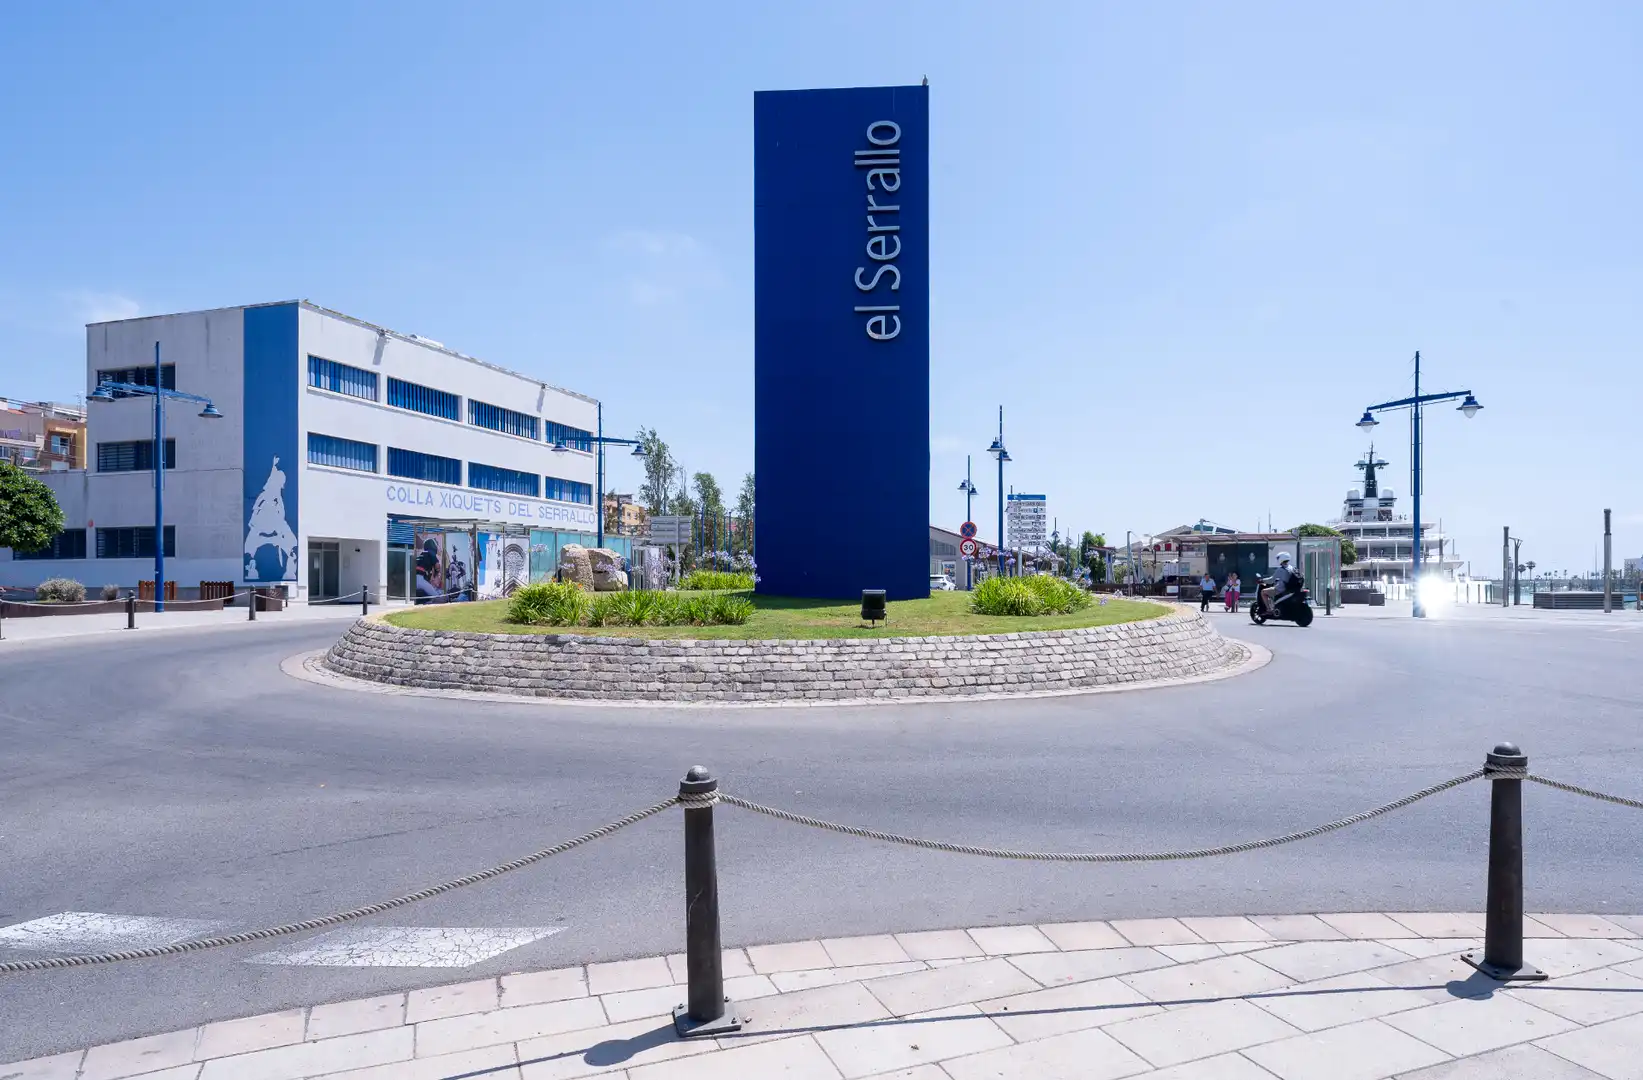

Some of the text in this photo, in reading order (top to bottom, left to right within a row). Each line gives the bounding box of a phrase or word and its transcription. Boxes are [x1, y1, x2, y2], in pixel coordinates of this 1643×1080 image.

[854, 120, 902, 340] el Serrallo
[386, 485, 596, 525] COLLA XIQUETS DEL SERRALLO
